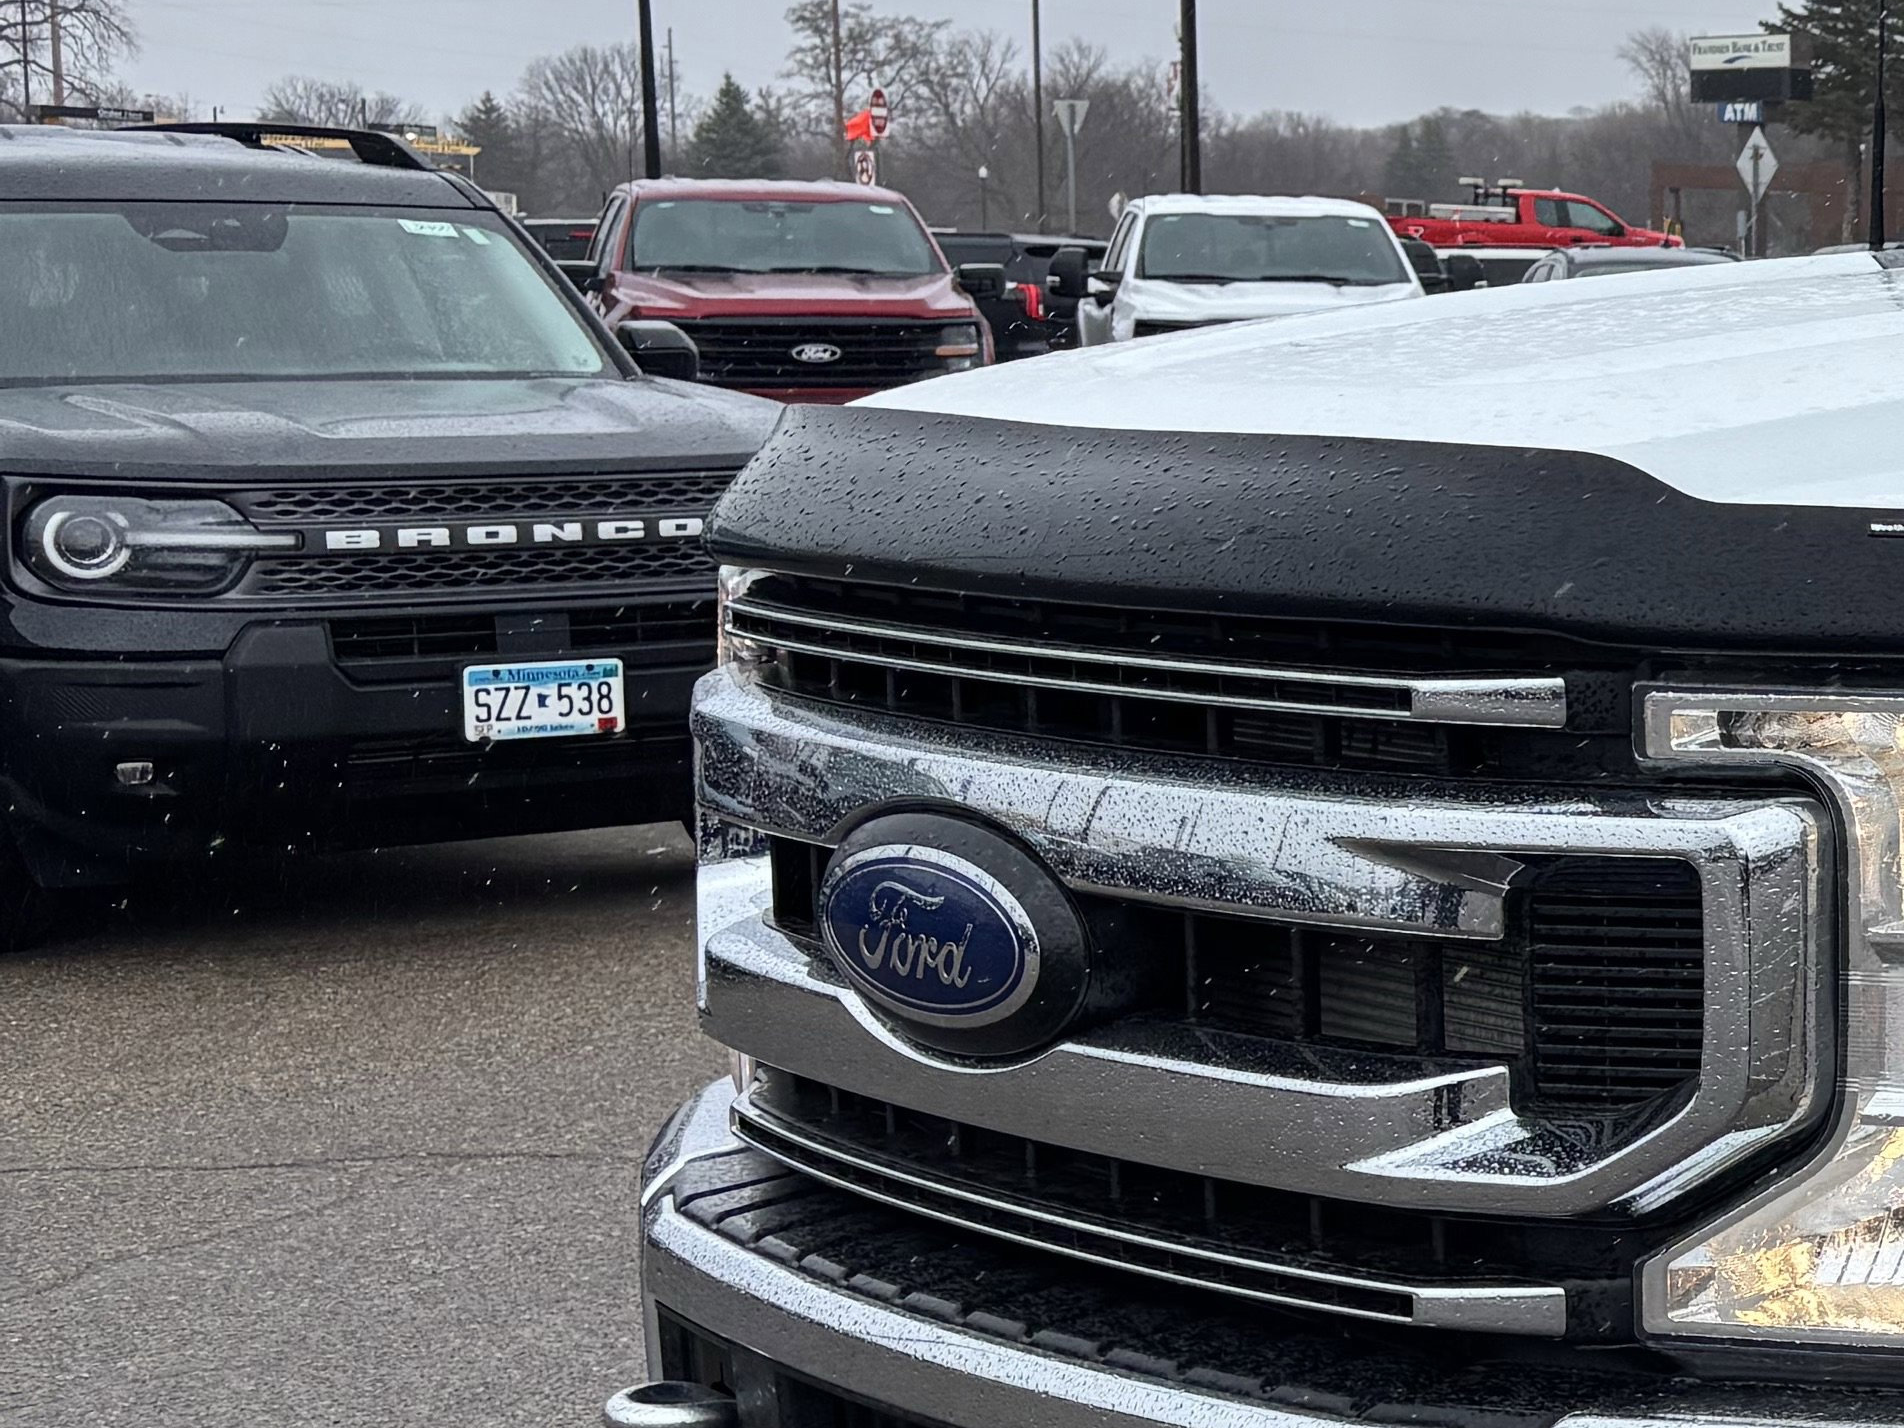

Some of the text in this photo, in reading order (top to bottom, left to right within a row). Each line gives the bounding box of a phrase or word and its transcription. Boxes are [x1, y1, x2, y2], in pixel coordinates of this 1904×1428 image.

[1723, 103, 1758, 122] ATM
[325, 518, 704, 550] BRONCO
[507, 668, 579, 683] Minnesota
[474, 681, 614, 723] SZZ 538
[858, 880, 972, 988] Ford
